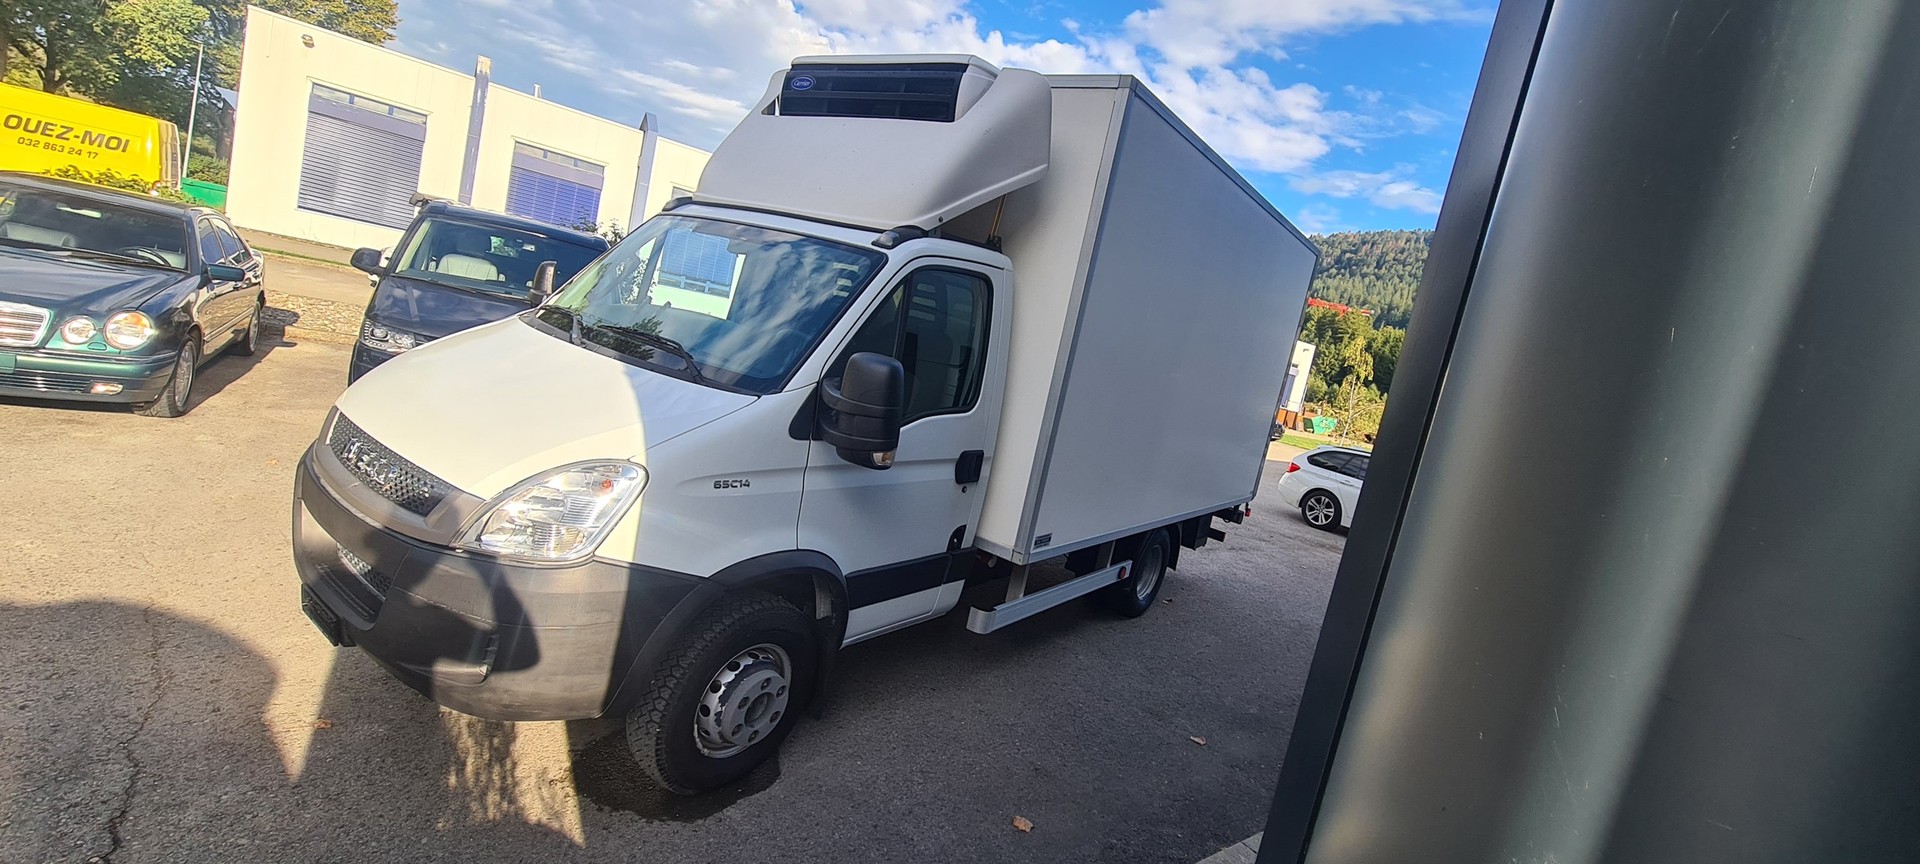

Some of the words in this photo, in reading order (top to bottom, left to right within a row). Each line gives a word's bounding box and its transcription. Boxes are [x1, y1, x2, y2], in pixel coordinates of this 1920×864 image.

[793, 79, 811, 87] Carrier
[3, 114, 130, 153] OUEZ-MOI
[17, 136, 40, 148] 032
[42, 142, 65, 153] 863
[67, 147, 82, 156] 24
[87, 151, 98, 160] 17
[713, 479, 750, 489] 65C14
